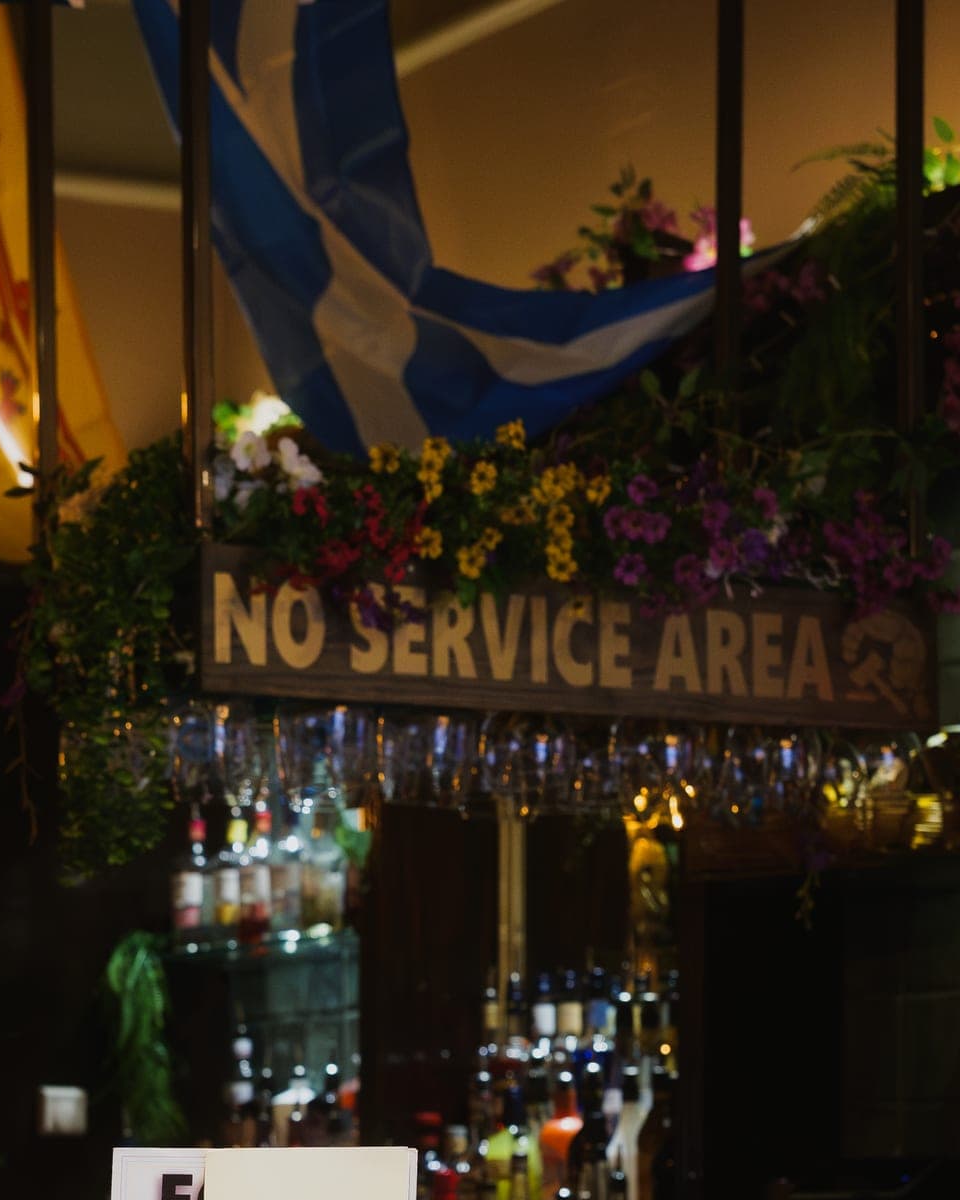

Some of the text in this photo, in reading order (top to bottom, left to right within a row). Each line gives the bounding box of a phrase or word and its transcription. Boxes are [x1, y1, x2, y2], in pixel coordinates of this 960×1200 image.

[213, 572, 836, 701] NO SERVICE AREA
